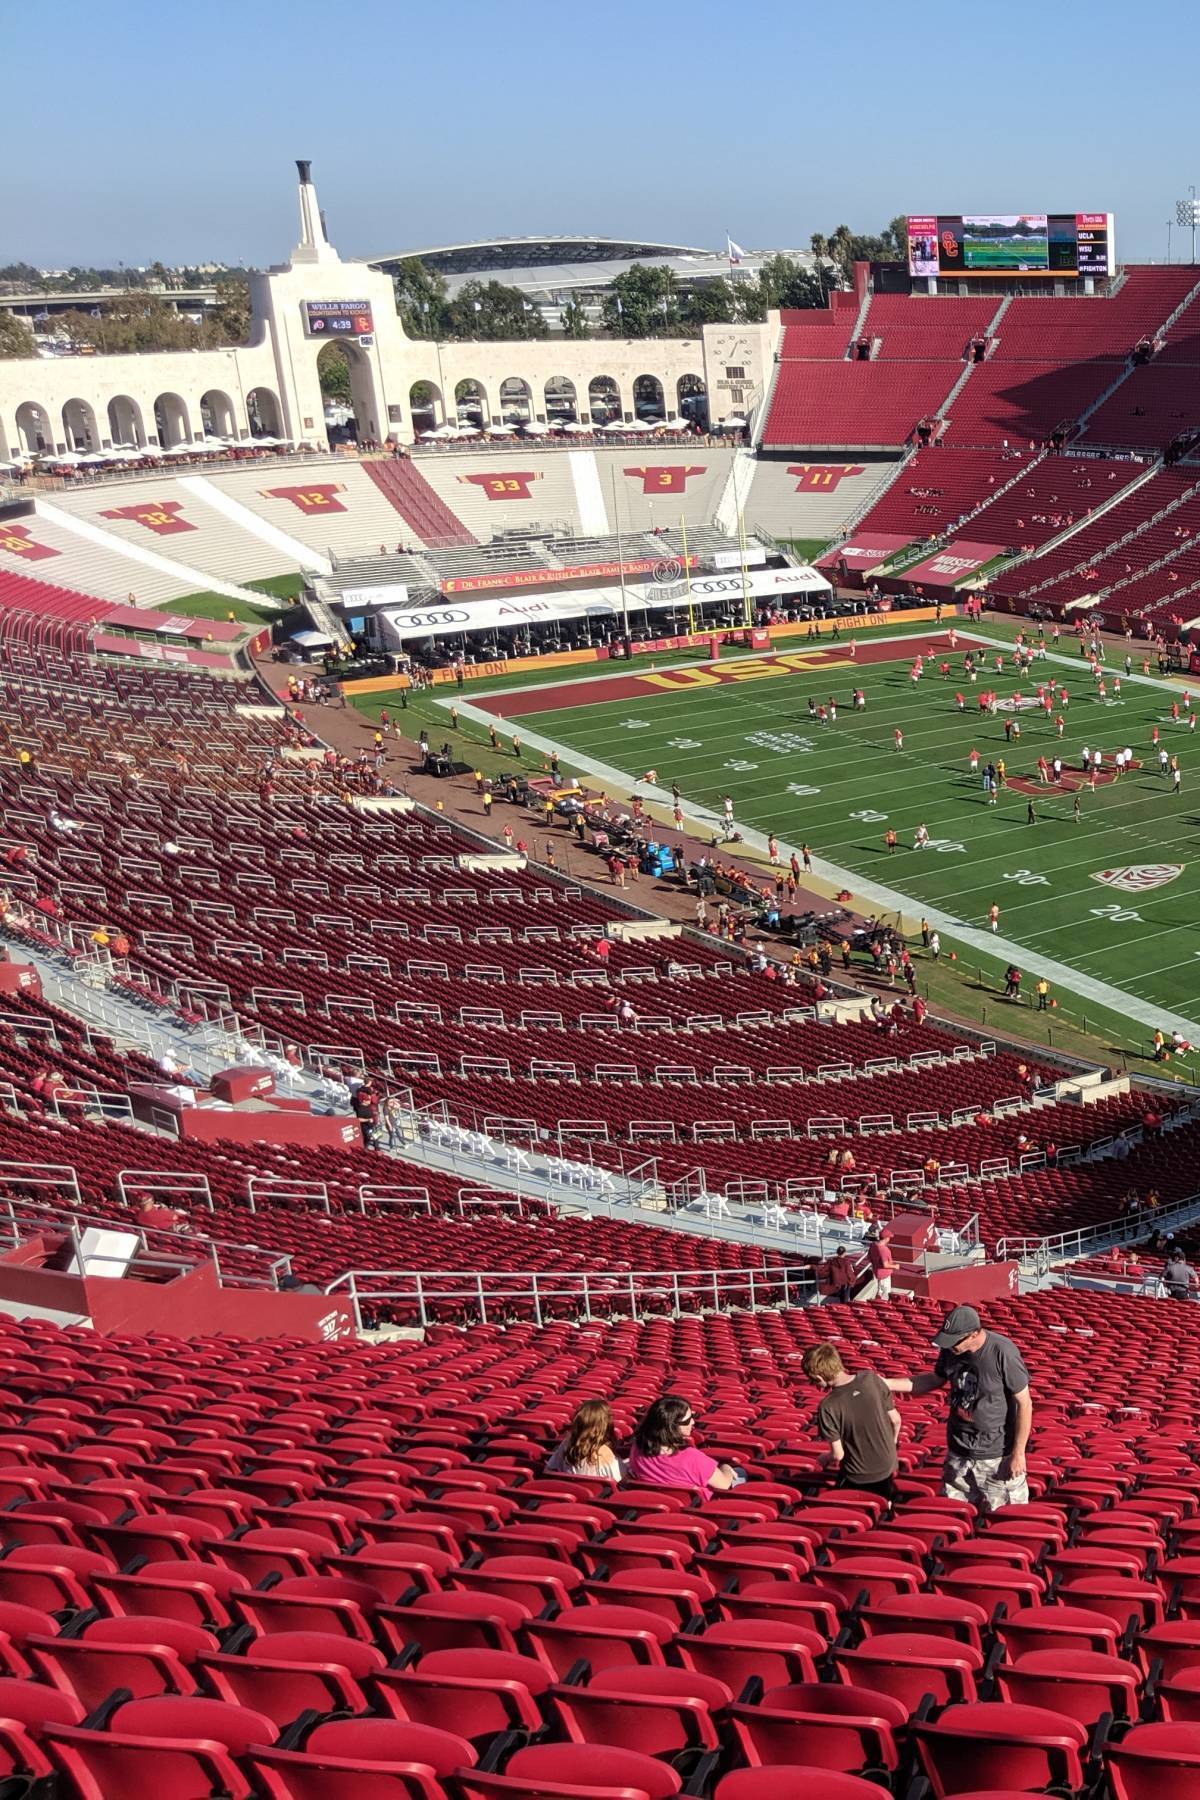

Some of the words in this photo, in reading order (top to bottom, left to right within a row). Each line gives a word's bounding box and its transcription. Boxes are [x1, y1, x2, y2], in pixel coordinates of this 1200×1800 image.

[489, 480, 520, 491] 33
[659, 474, 672, 486] 3
[811, 473, 832, 485] 11
[297, 492, 335, 506] 12
[137, 511, 177, 525] 32
[477, 577, 500, 587] FRANK
[515, 574, 538, 583] BLAIR
[579, 567, 601, 576] BLAIR
[628, 563, 650, 572] BAND
[773, 571, 818, 584] Audi
[498, 601, 550, 616] Audi
[837, 615, 866, 628] FIGHT
[870, 614, 888, 626] ON!
[484, 661, 509, 675] ON!
[634, 651, 858, 689] USC
[849, 809, 889, 823] 50
[1003, 869, 1048, 886] 30
[1090, 904, 1138, 922] 20
